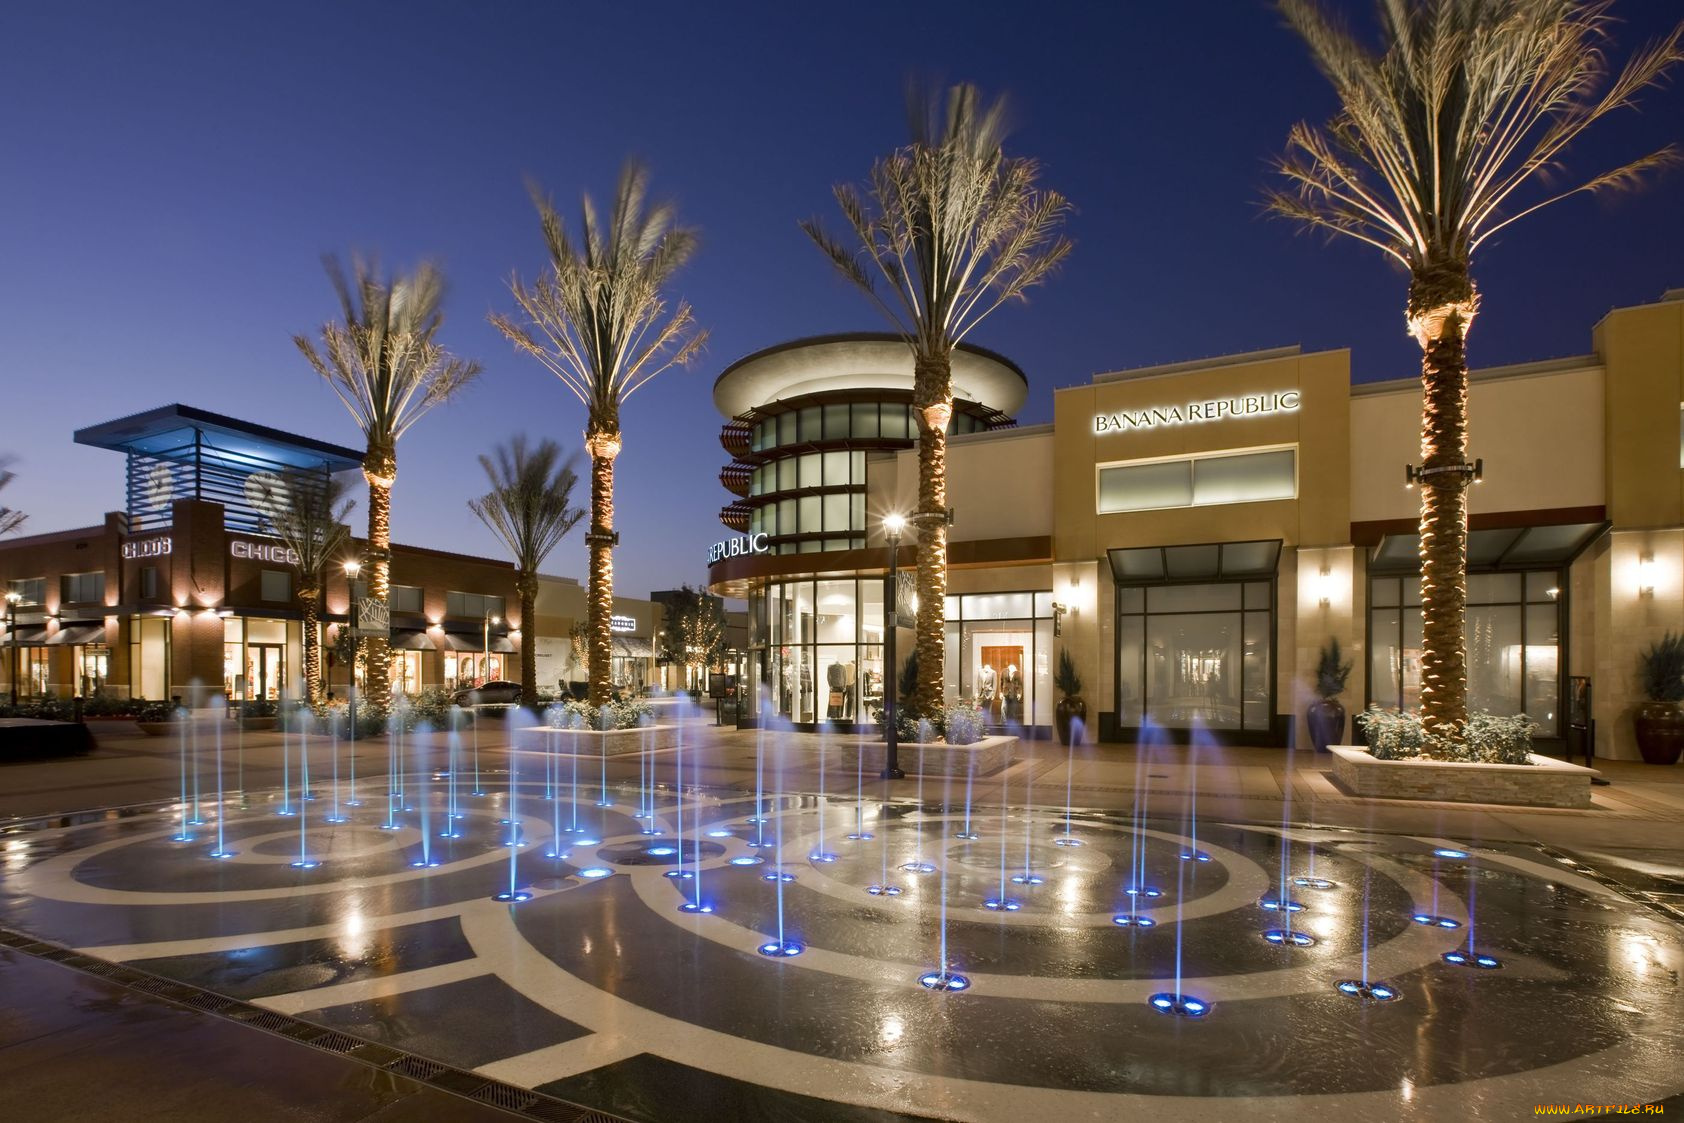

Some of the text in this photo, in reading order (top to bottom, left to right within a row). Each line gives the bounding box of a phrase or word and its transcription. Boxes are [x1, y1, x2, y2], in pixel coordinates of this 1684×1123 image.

[1094, 391, 1300, 433] BANANA REPUBLIC
[708, 532, 769, 563] REPUBLIC
